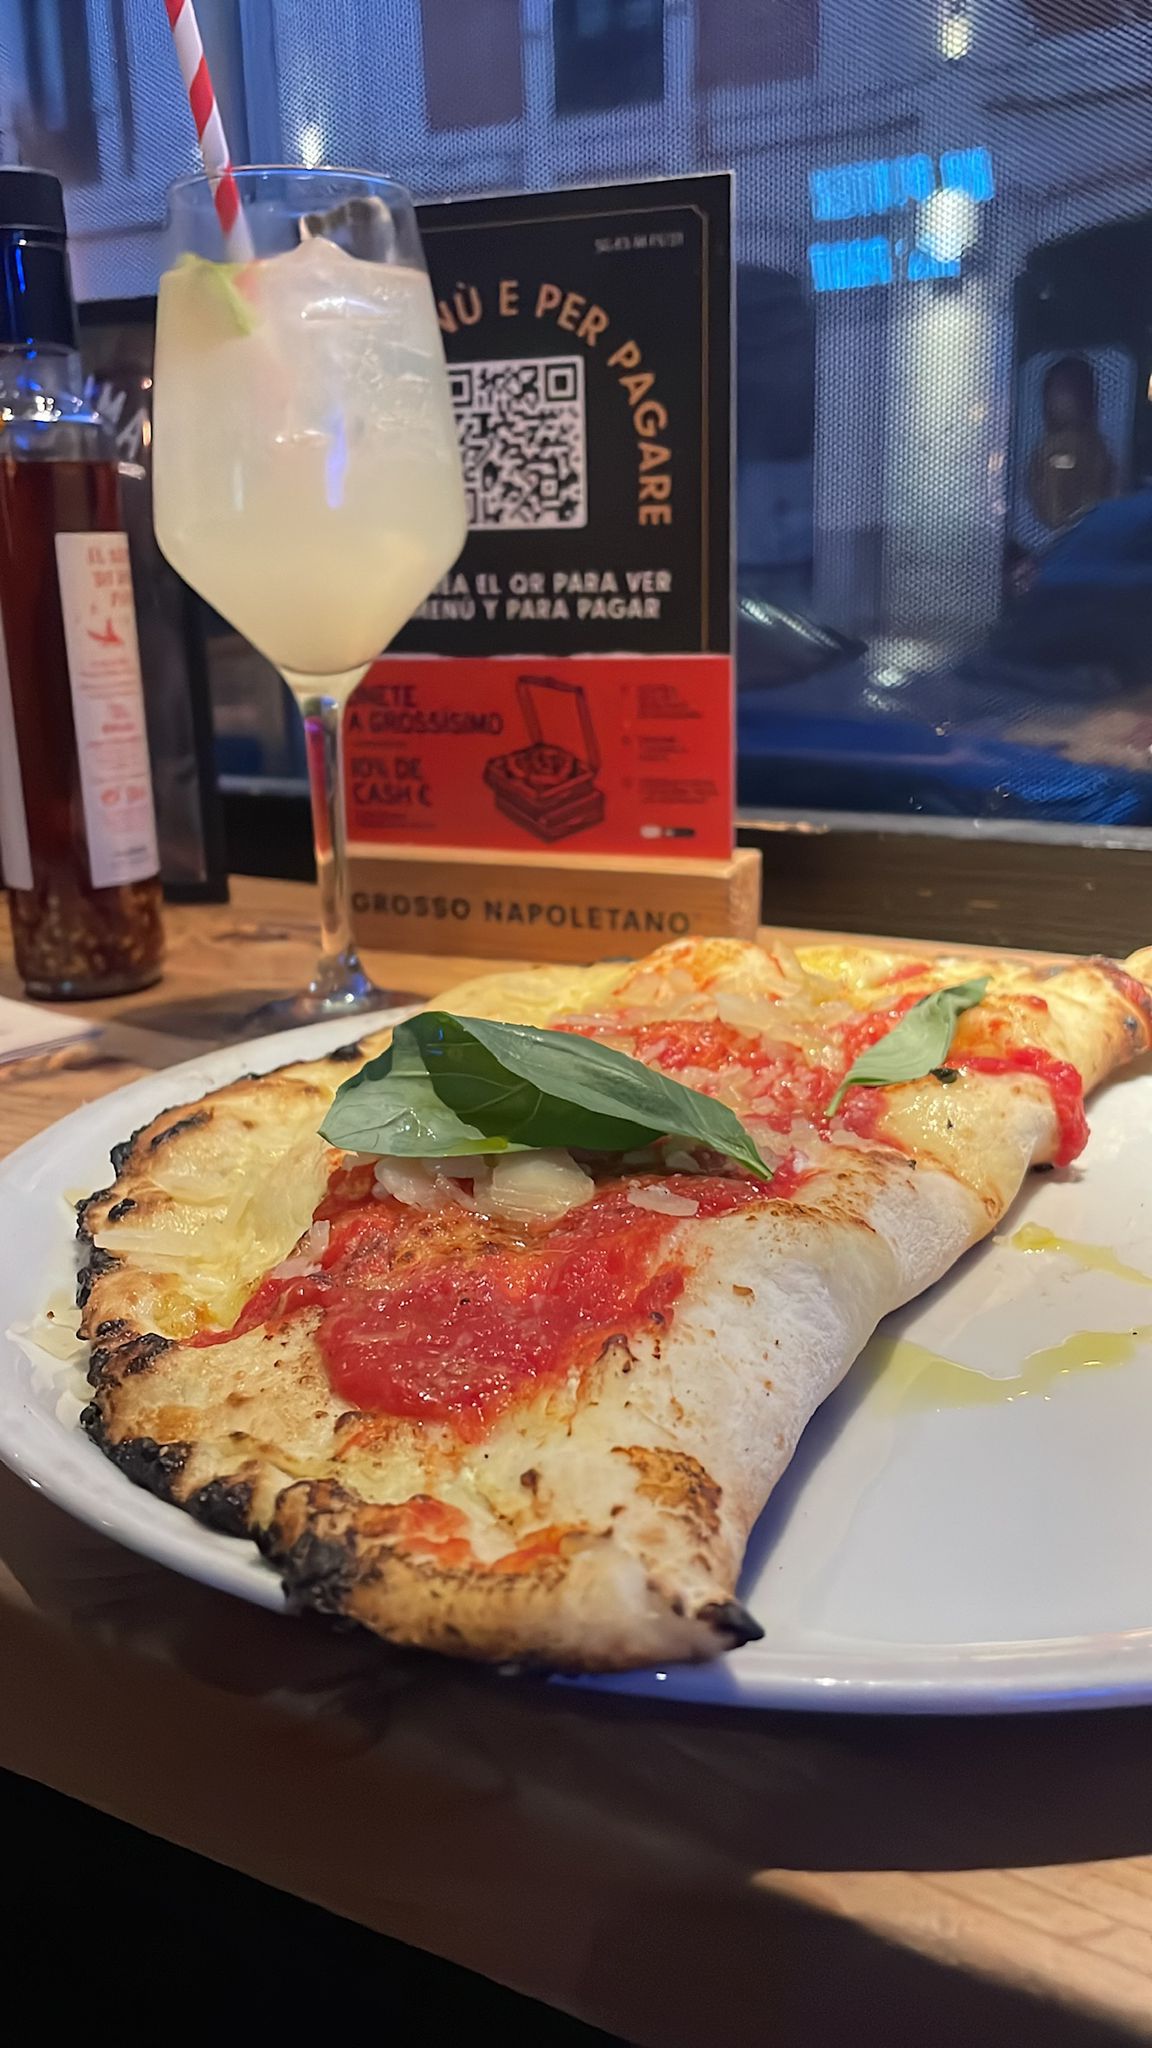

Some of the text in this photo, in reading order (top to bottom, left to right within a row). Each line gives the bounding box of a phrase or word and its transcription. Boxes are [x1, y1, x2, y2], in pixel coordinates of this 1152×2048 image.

[439, 280, 673, 526] NÙ E PER PAGARE
[475, 573, 501, 595] EL
[552, 571, 618, 594] PARA
[625, 570, 672, 593] VER
[482, 599, 500, 620] Y
[506, 598, 569, 621] PARA
[576, 598, 661, 620] PAGAR
[394, 757, 423, 780] DE
[351, 891, 691, 936] GROSSO NAPOLETANO
